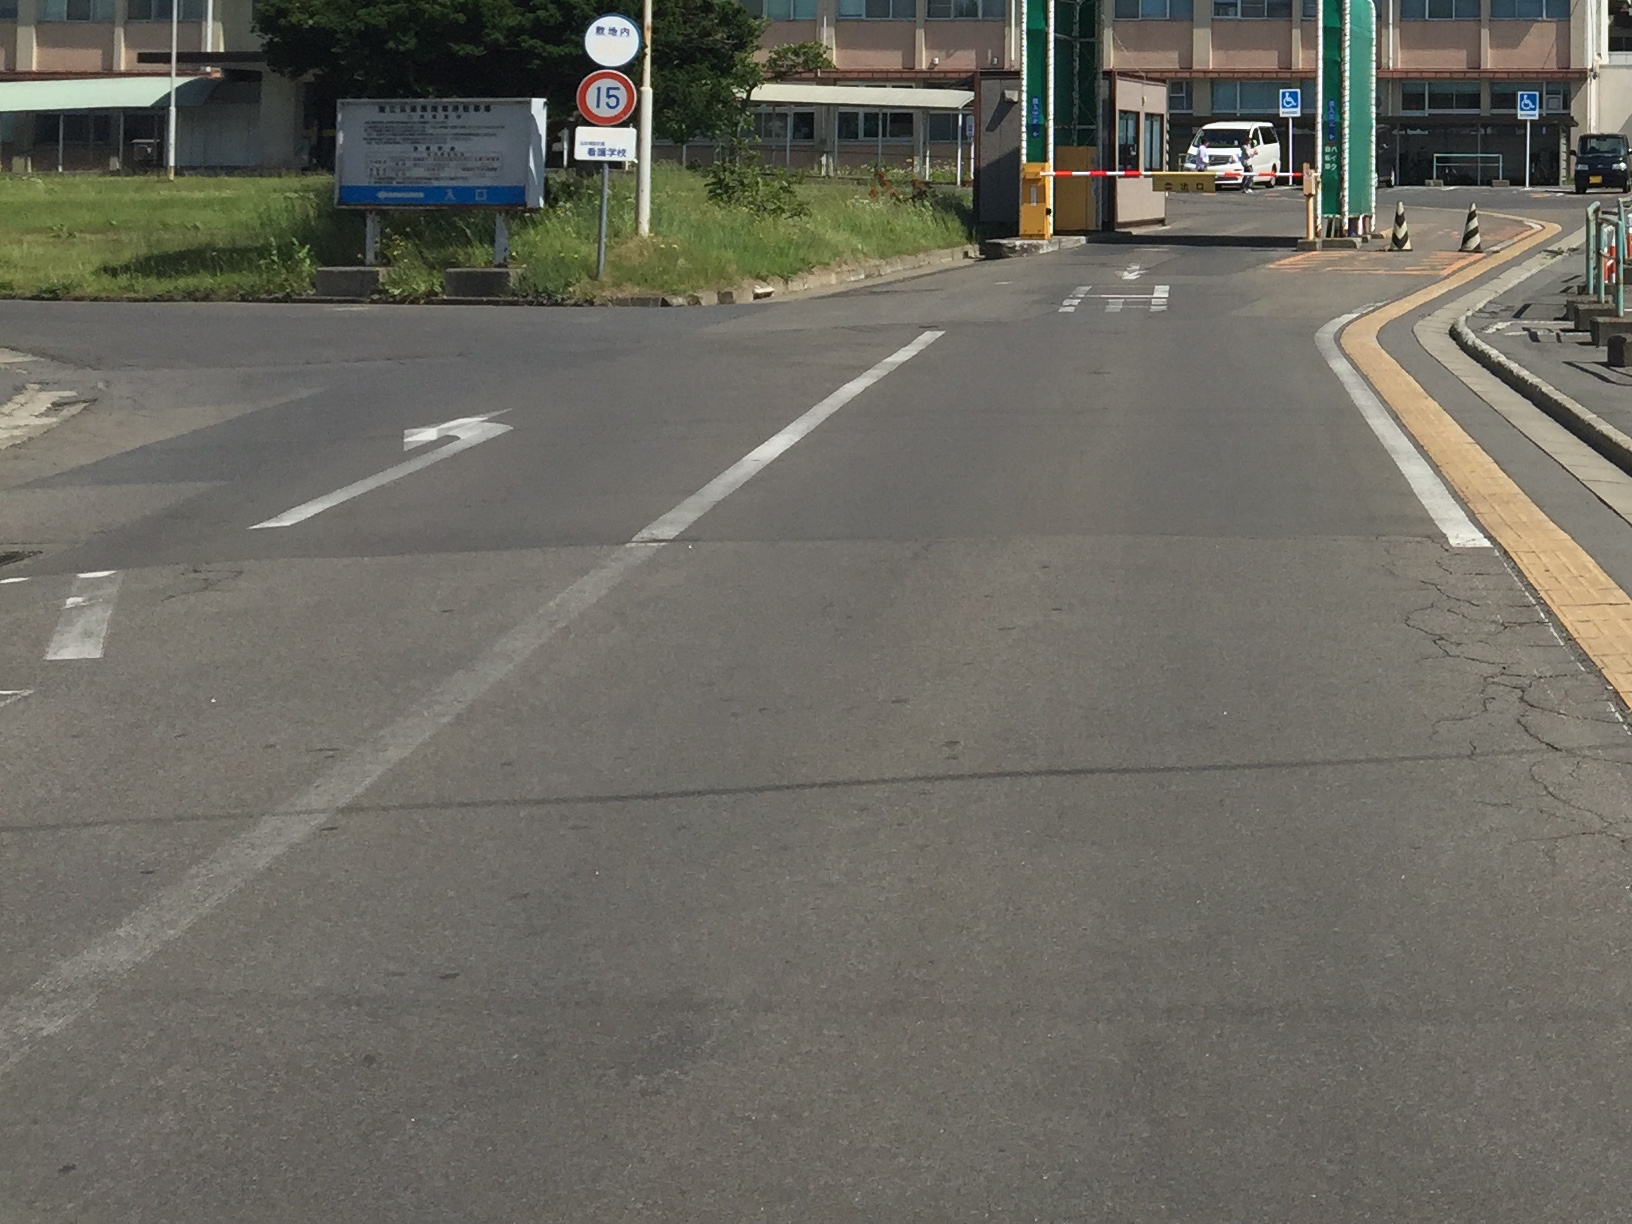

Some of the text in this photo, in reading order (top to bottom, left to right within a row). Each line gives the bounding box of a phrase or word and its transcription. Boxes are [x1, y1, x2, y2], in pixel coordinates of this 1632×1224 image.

[595, 26, 630, 37] 敷地内
[596, 86, 621, 110] 15
[587, 147, 627, 157] 看護学校
